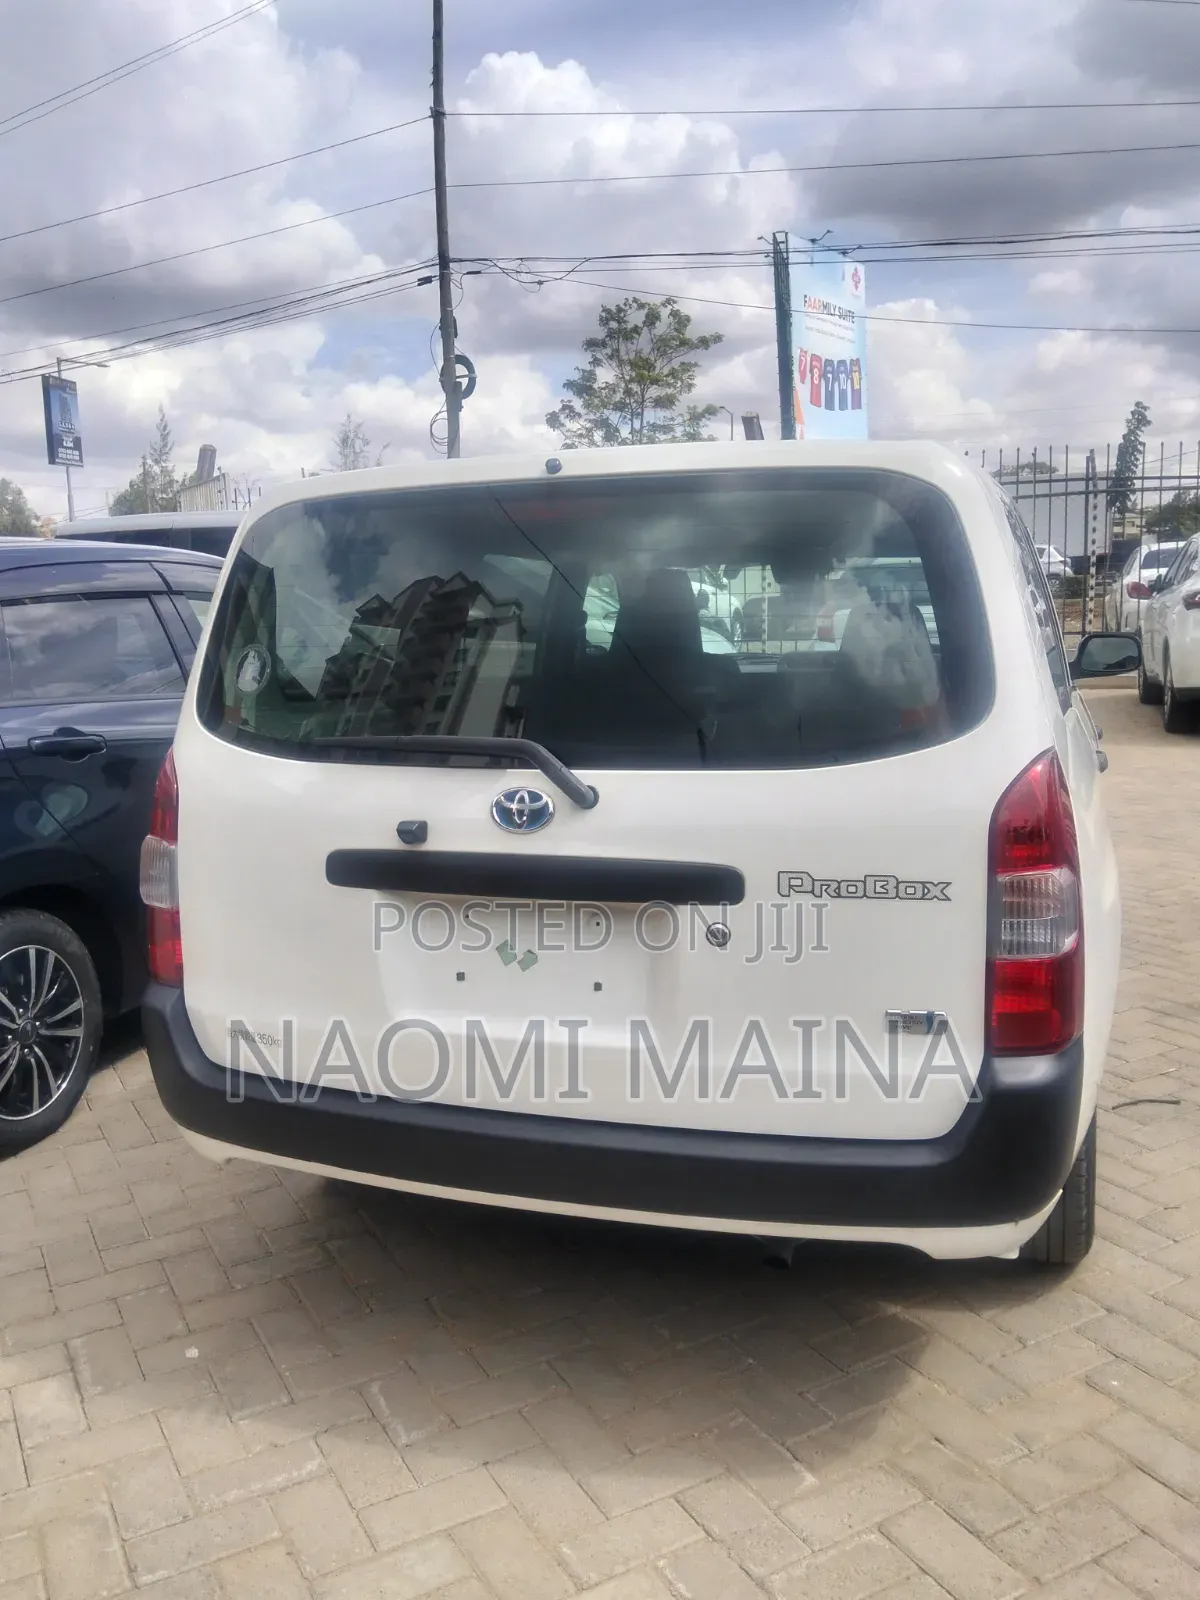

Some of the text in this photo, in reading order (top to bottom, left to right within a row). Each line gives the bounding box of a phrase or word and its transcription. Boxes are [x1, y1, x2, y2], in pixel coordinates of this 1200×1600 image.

[838, 306, 855, 324] SUITE
[800, 356, 806, 371] 7
[813, 368, 820, 385] 8
[827, 373, 833, 391] 7
[838, 373, 847, 390] 10
